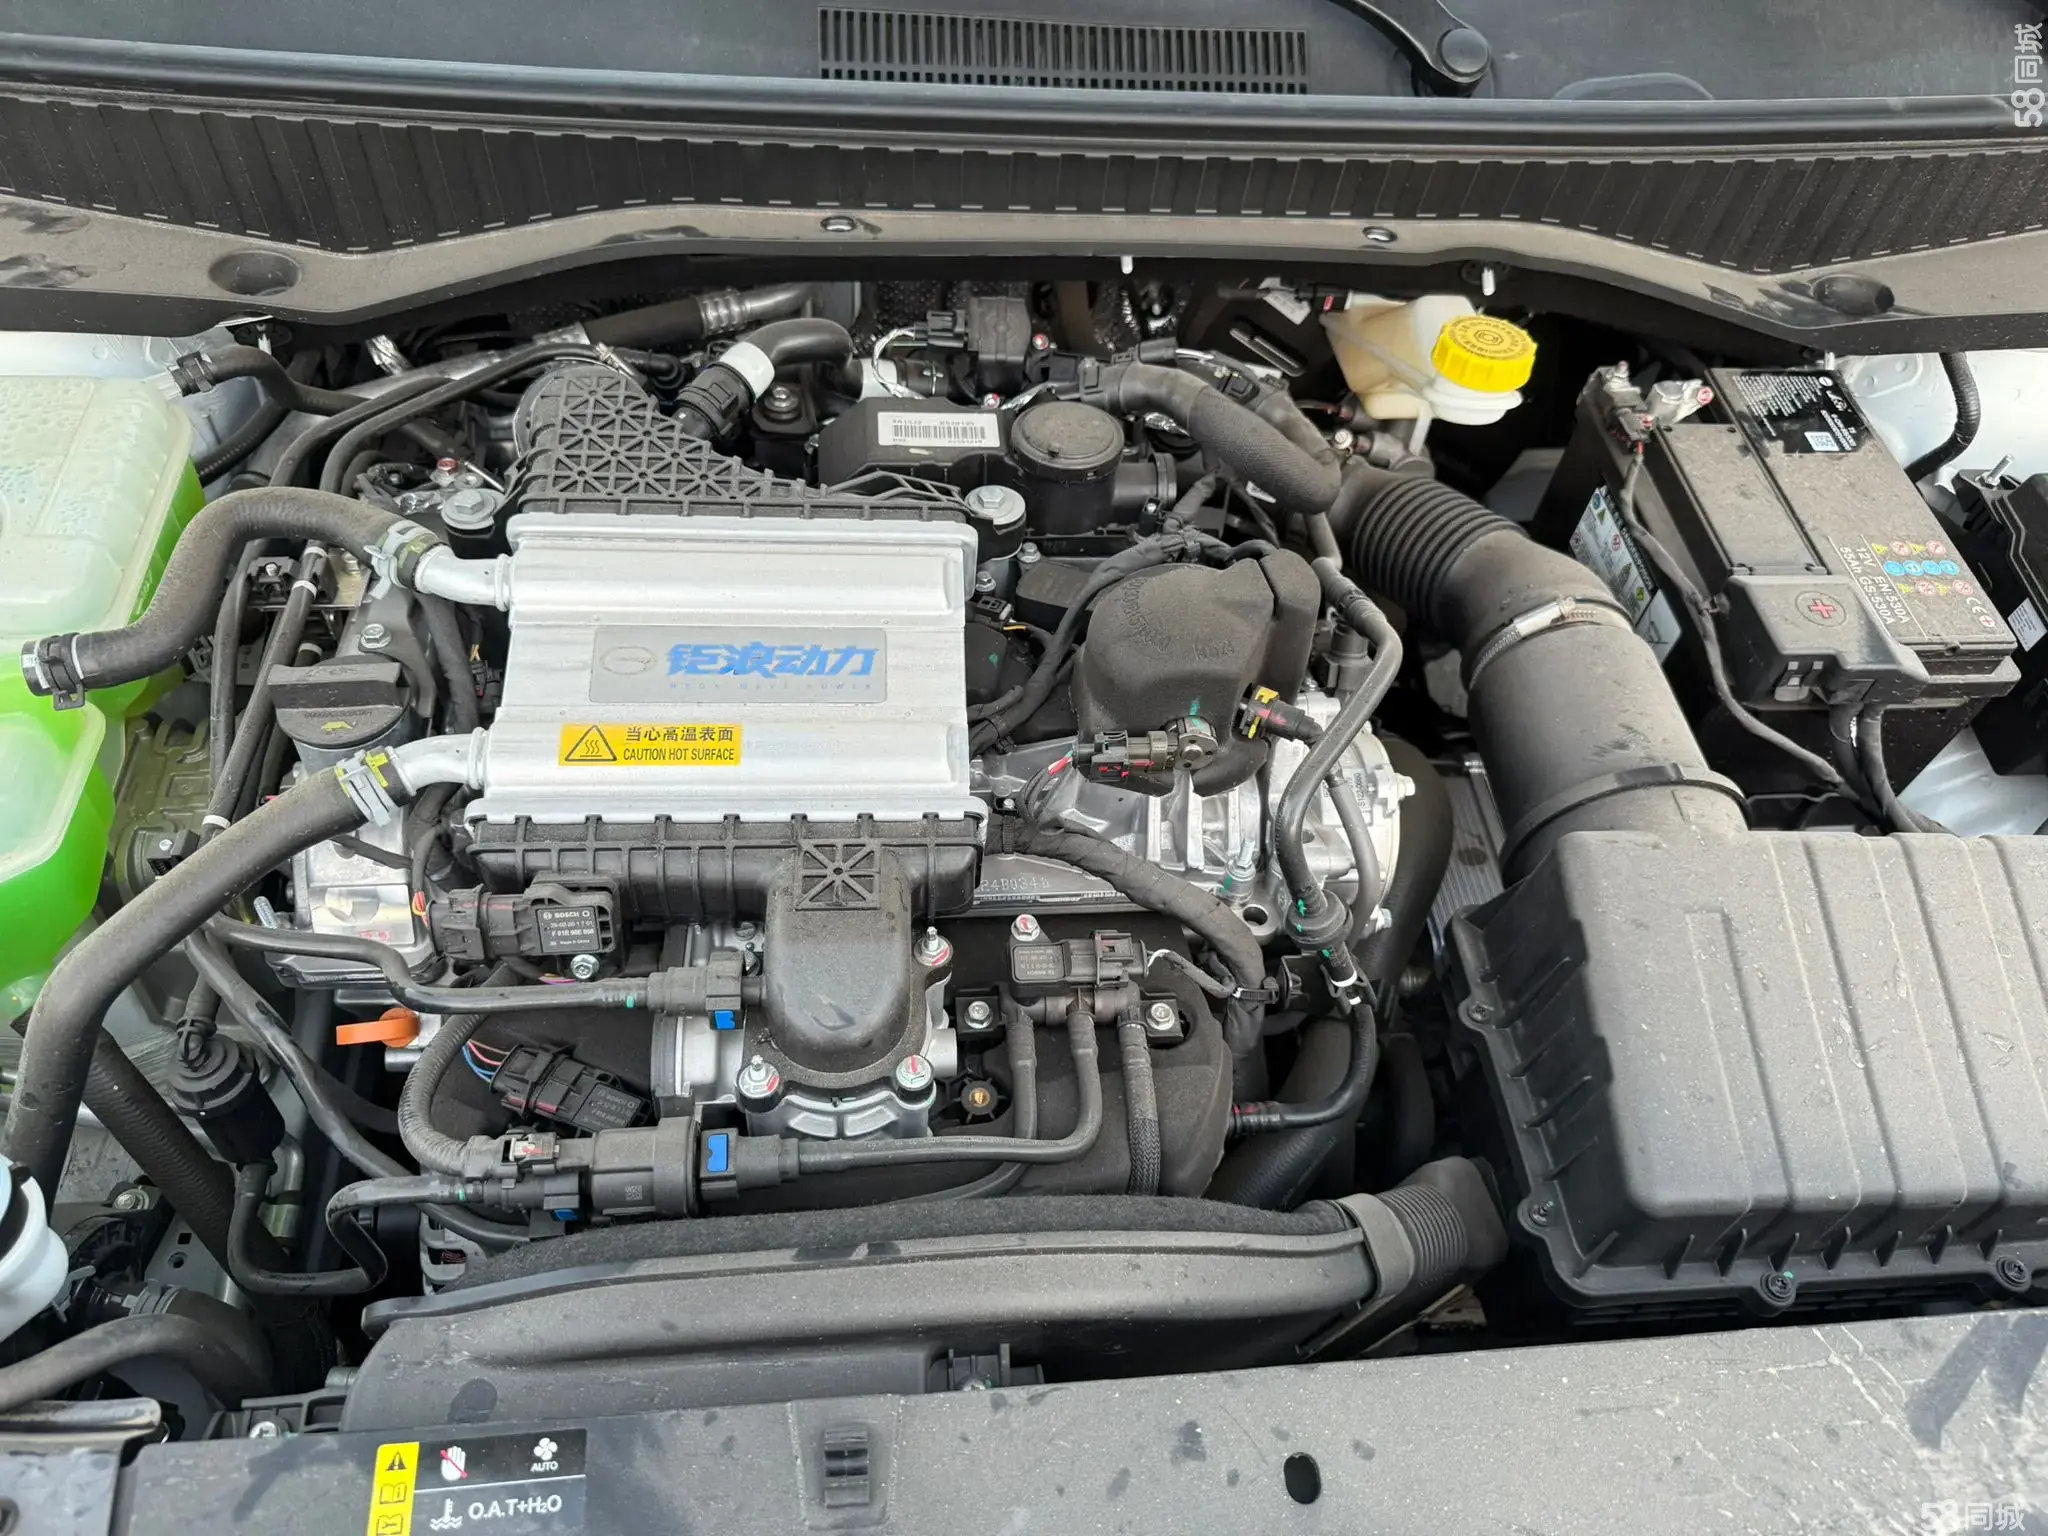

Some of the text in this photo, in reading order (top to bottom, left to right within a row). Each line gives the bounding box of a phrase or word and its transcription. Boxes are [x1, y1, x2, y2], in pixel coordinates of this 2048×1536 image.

[1839, 546, 1896, 625] 55Ah GS:530A
[1855, 547, 1910, 624] 12V EN:530A
[626, 726, 734, 742] 当心高温表面
[623, 748, 734, 761] CAUTION HOT SURFACE
[554, 911, 579, 919] BOSCH
[530, 1461, 559, 1472] AUTO
